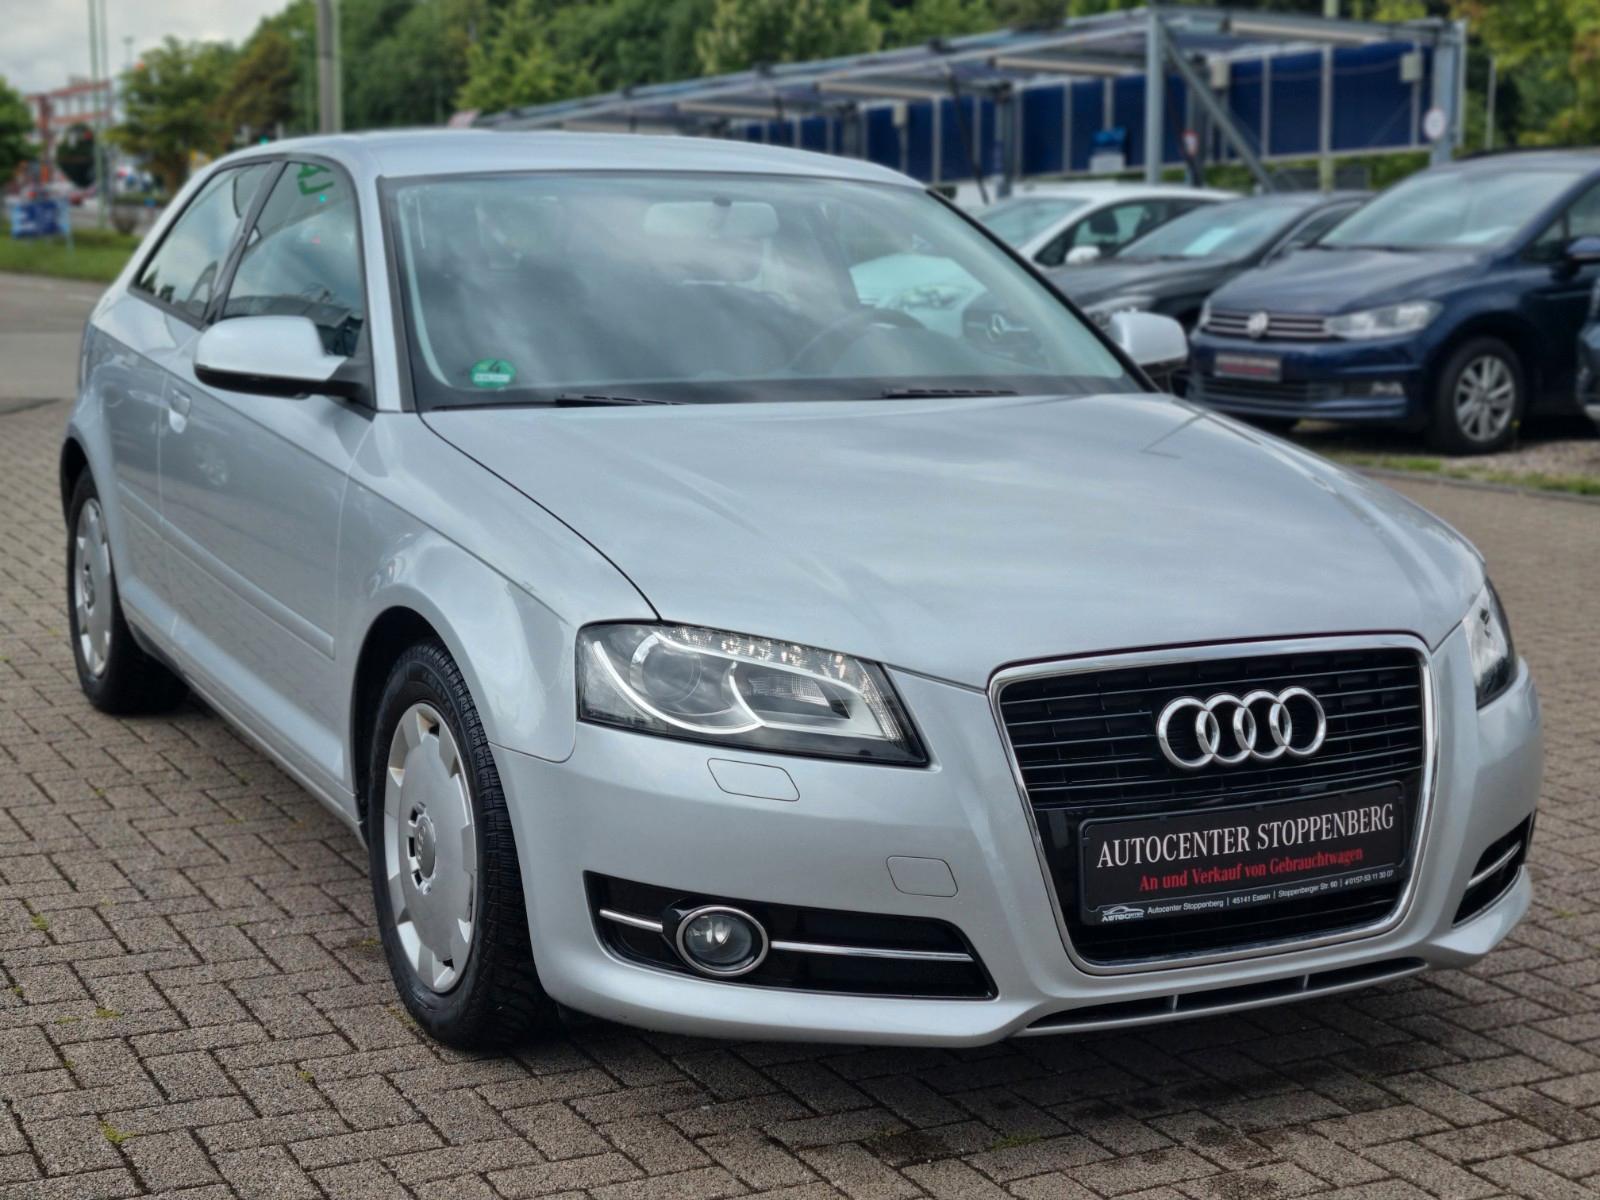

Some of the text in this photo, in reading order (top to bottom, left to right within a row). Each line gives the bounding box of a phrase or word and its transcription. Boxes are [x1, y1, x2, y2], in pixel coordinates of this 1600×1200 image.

[1096, 803, 1394, 868] AUTOCENTER STOPPENBERG
[1139, 848, 1363, 891] An und Verkauf von Gebrauchtwagen
[1147, 904, 1182, 914] Autocenter
[1183, 898, 1224, 911] Stoppenberg
[1278, 886, 1319, 899] Stoppenberger
[1319, 880, 1330, 891] Str.
